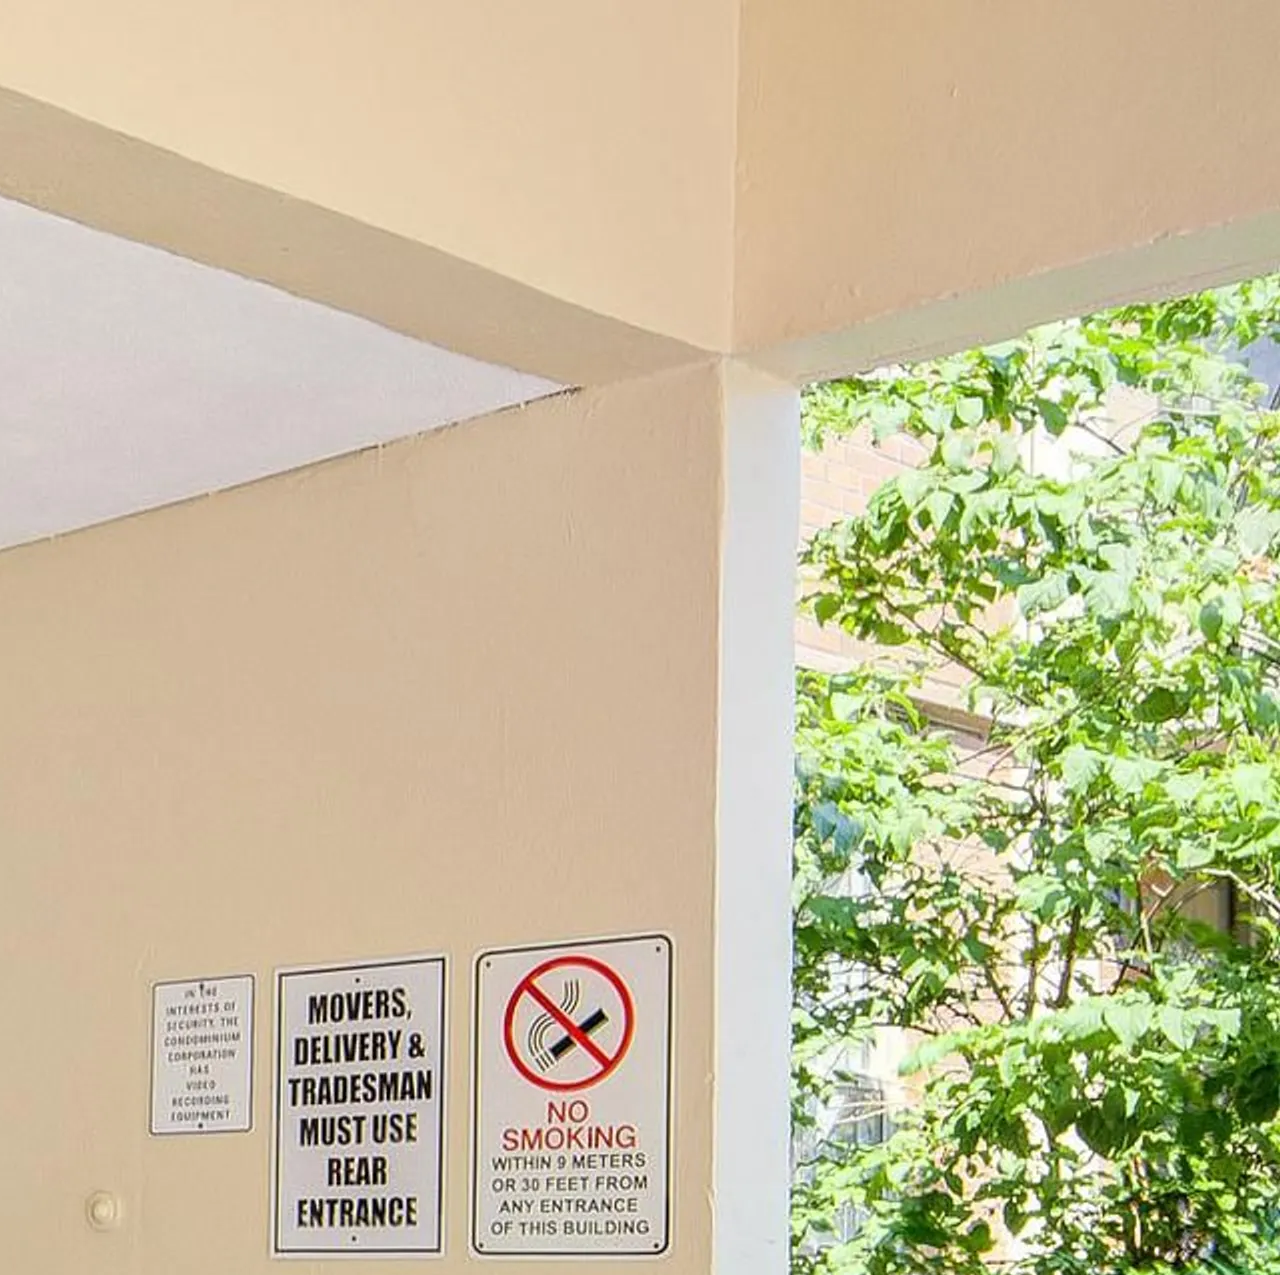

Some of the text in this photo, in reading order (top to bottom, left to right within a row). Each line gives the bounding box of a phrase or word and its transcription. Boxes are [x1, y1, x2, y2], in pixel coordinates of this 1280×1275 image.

[166, 1001, 235, 1016] INTERESTS OF
[308, 988, 412, 1024] MOVERS,
[221, 1016, 238, 1027] THE
[164, 1031, 241, 1047] CONDOMINIUM
[168, 1049, 236, 1063] CORPORATION
[294, 1030, 425, 1066] DELIVERY &
[190, 1064, 209, 1076] HAS
[186, 1080, 216, 1091] VIDEO
[288, 1070, 432, 1107] TRADESMAN
[172, 1094, 230, 1107] RECORDING
[171, 1109, 229, 1122] EQUIPMENT
[548, 1100, 588, 1124] NO
[300, 1113, 417, 1146] MUST USE
[502, 1126, 636, 1151] SMOKING
[492, 1153, 646, 1171] WITHIN 9 METERS
[328, 1156, 387, 1186] REAR
[492, 1175, 647, 1193] OR 30 FEET FROM
[297, 1197, 417, 1228] ENTRANCE
[499, 1198, 638, 1213] ANY ENTRANCE
[491, 1219, 649, 1236] OF THIS BUILDING
